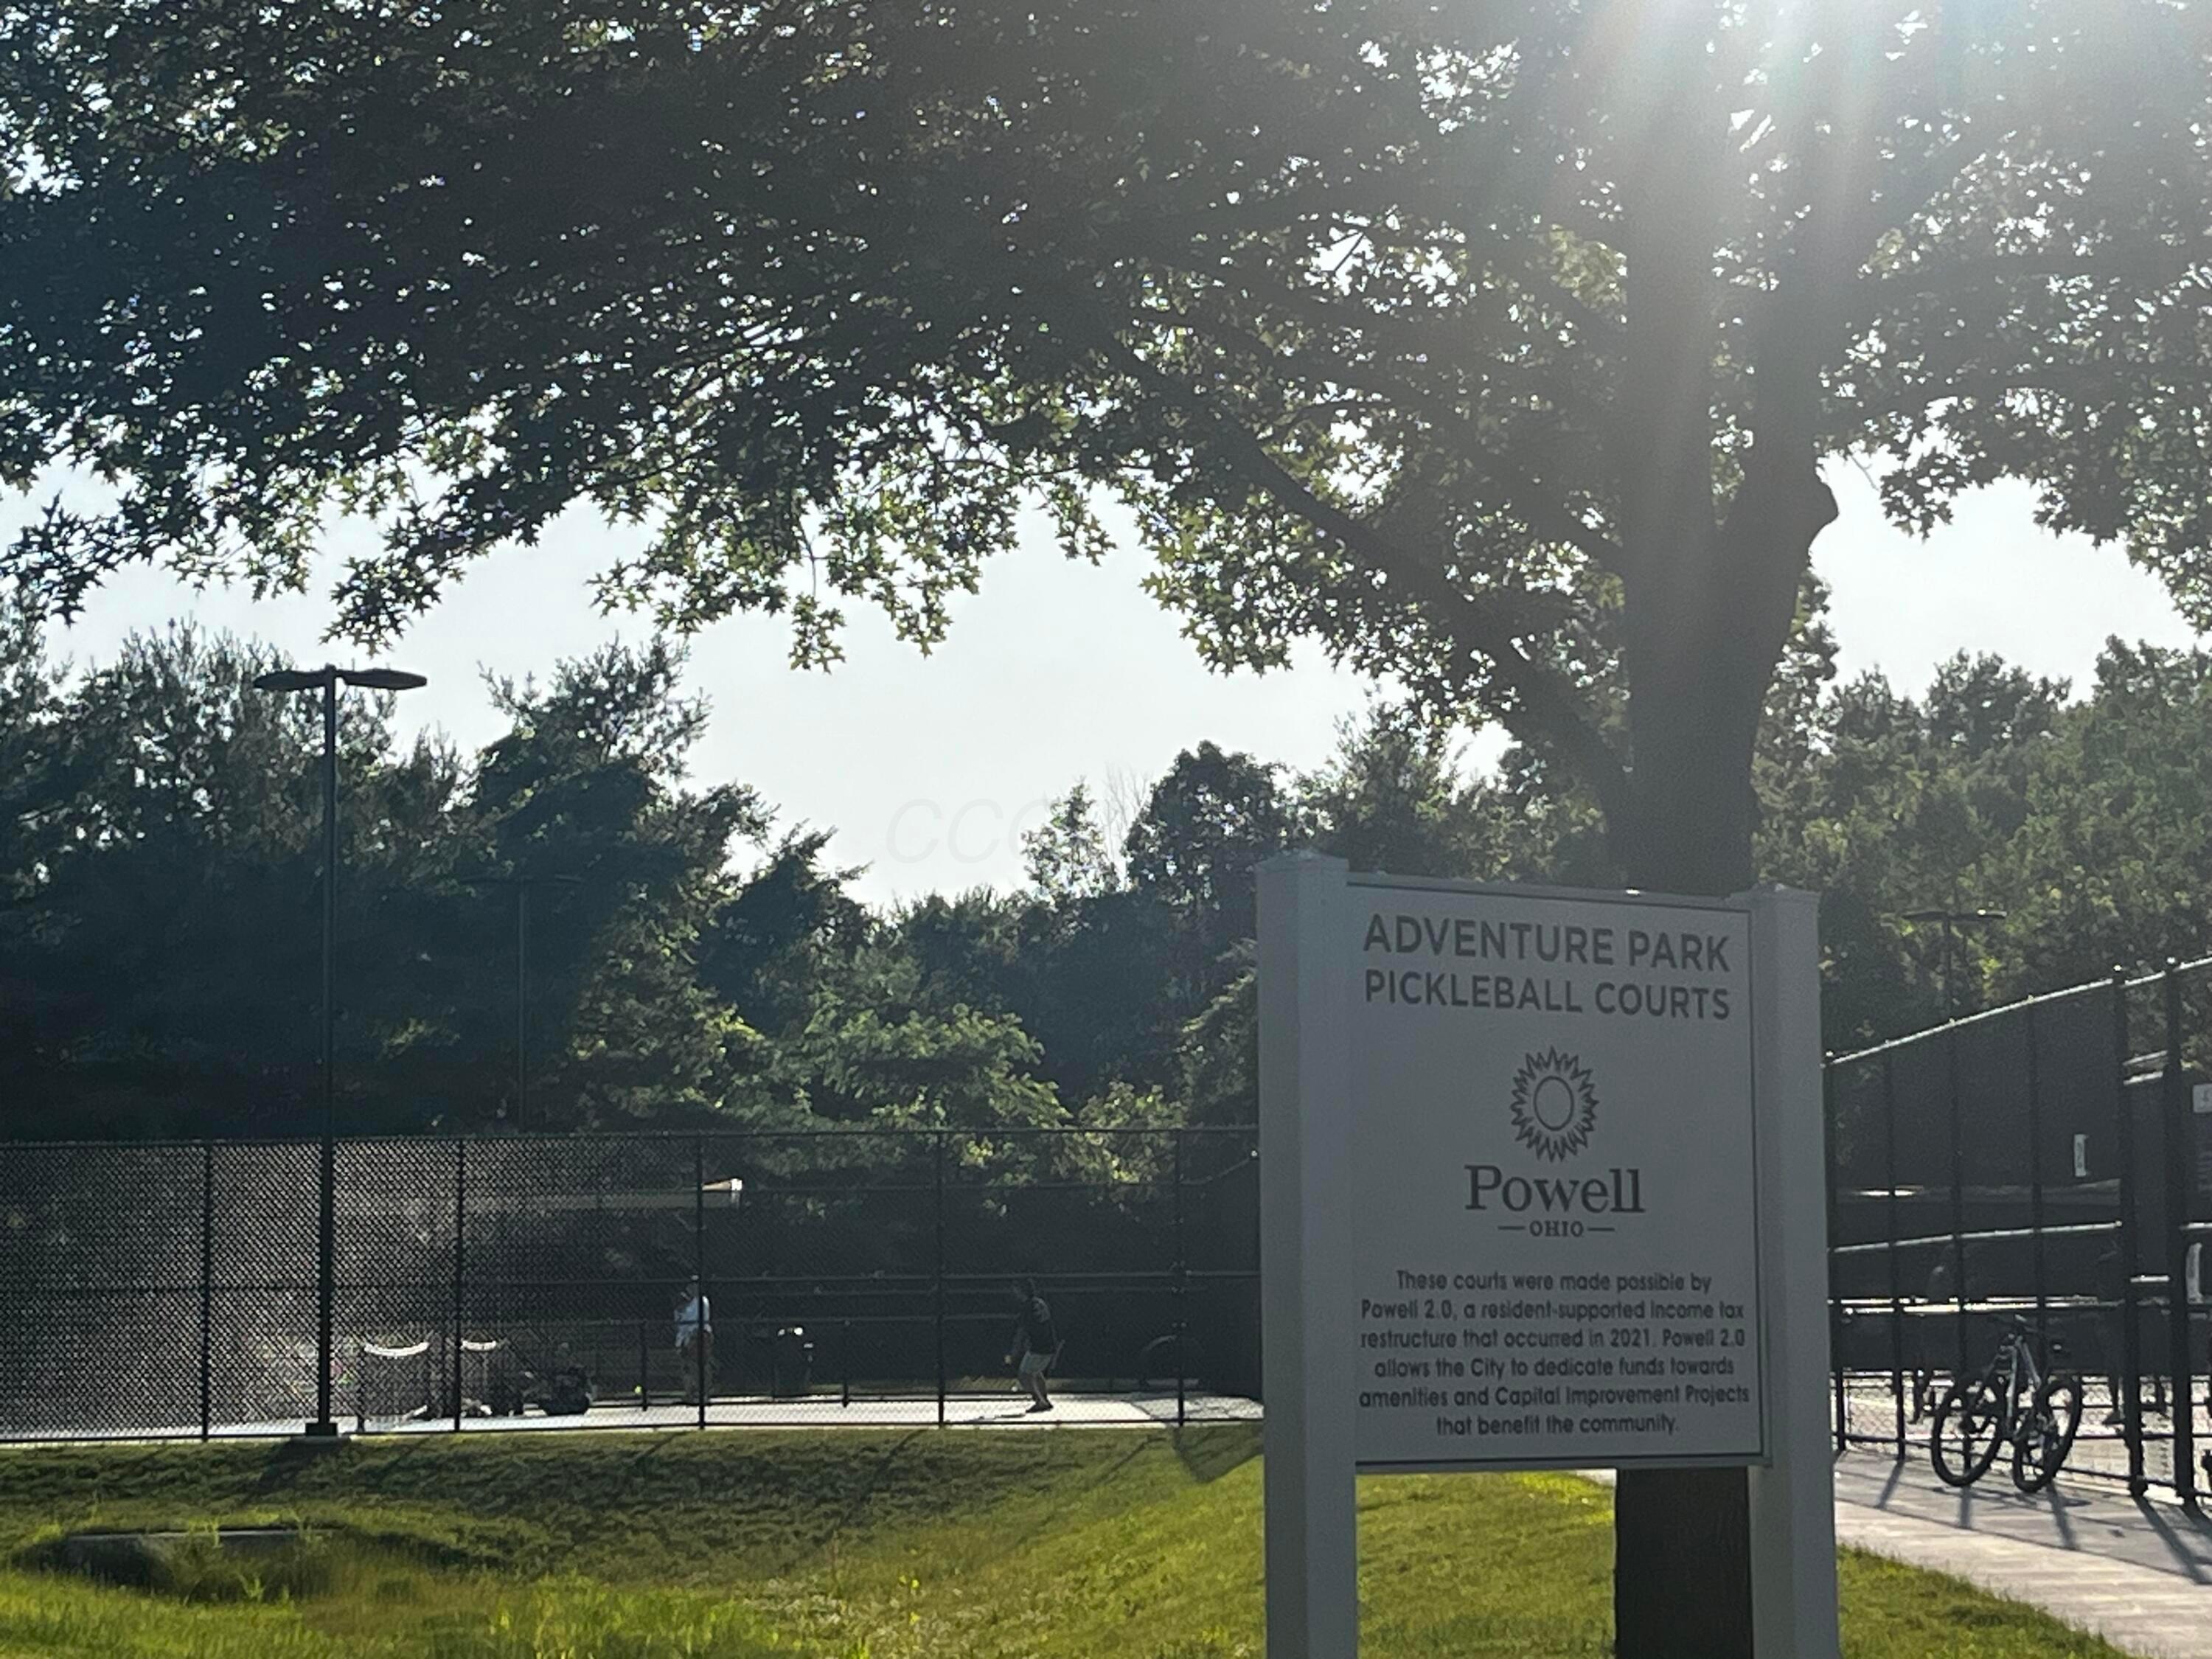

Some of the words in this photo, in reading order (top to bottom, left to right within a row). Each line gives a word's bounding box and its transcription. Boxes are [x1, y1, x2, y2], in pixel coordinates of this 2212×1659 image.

[1363, 913, 1615, 966] ADVENTURE
[1628, 930, 1731, 973] PARK
[1365, 969, 1583, 1014] PICKLEBALL
[1595, 981, 1731, 1020] COURTS
[1464, 1164, 1646, 1214] Powell
[1528, 1220, 1585, 1238] OHIO
[1396, 1269, 1448, 1291] These
[1453, 1270, 1508, 1291] courts
[1512, 1274, 1554, 1291] were
[1559, 1271, 1612, 1292] made
[1615, 1271, 1686, 1295] possible
[1689, 1271, 1713, 1295] by
[1360, 1298, 1419, 1320] Powell
[1463, 1303, 1476, 1320] a
[1719, 1300, 1745, 1320] tax
[1360, 1328, 1458, 1349] restructure
[1462, 1328, 1499, 1349] that
[1587, 1328, 1604, 1348] in
[1662, 1327, 1715, 1348] Powell
[1719, 1327, 1745, 1347] 2.0
[1374, 1357, 1430, 1378] allows
[1435, 1357, 1465, 1378] the
[1470, 1357, 1506, 1380] City
[1510, 1357, 1528, 1377] to
[1533, 1356, 1614, 1377] dedicate
[1618, 1356, 1665, 1376] funds
[1670, 1355, 1735, 1376] towards
[1358, 1386, 1449, 1408] amenities
[1453, 1385, 1489, 1407] and
[1494, 1385, 1561, 1409] Capital
[1565, 1384, 1680, 1409] Improvement
[1685, 1384, 1750, 1408] Projects
[1436, 1415, 1472, 1436] that
[1476, 1414, 1540, 1436] benefit
[1545, 1414, 1574, 1435] the
[1579, 1413, 1679, 1436] community.
